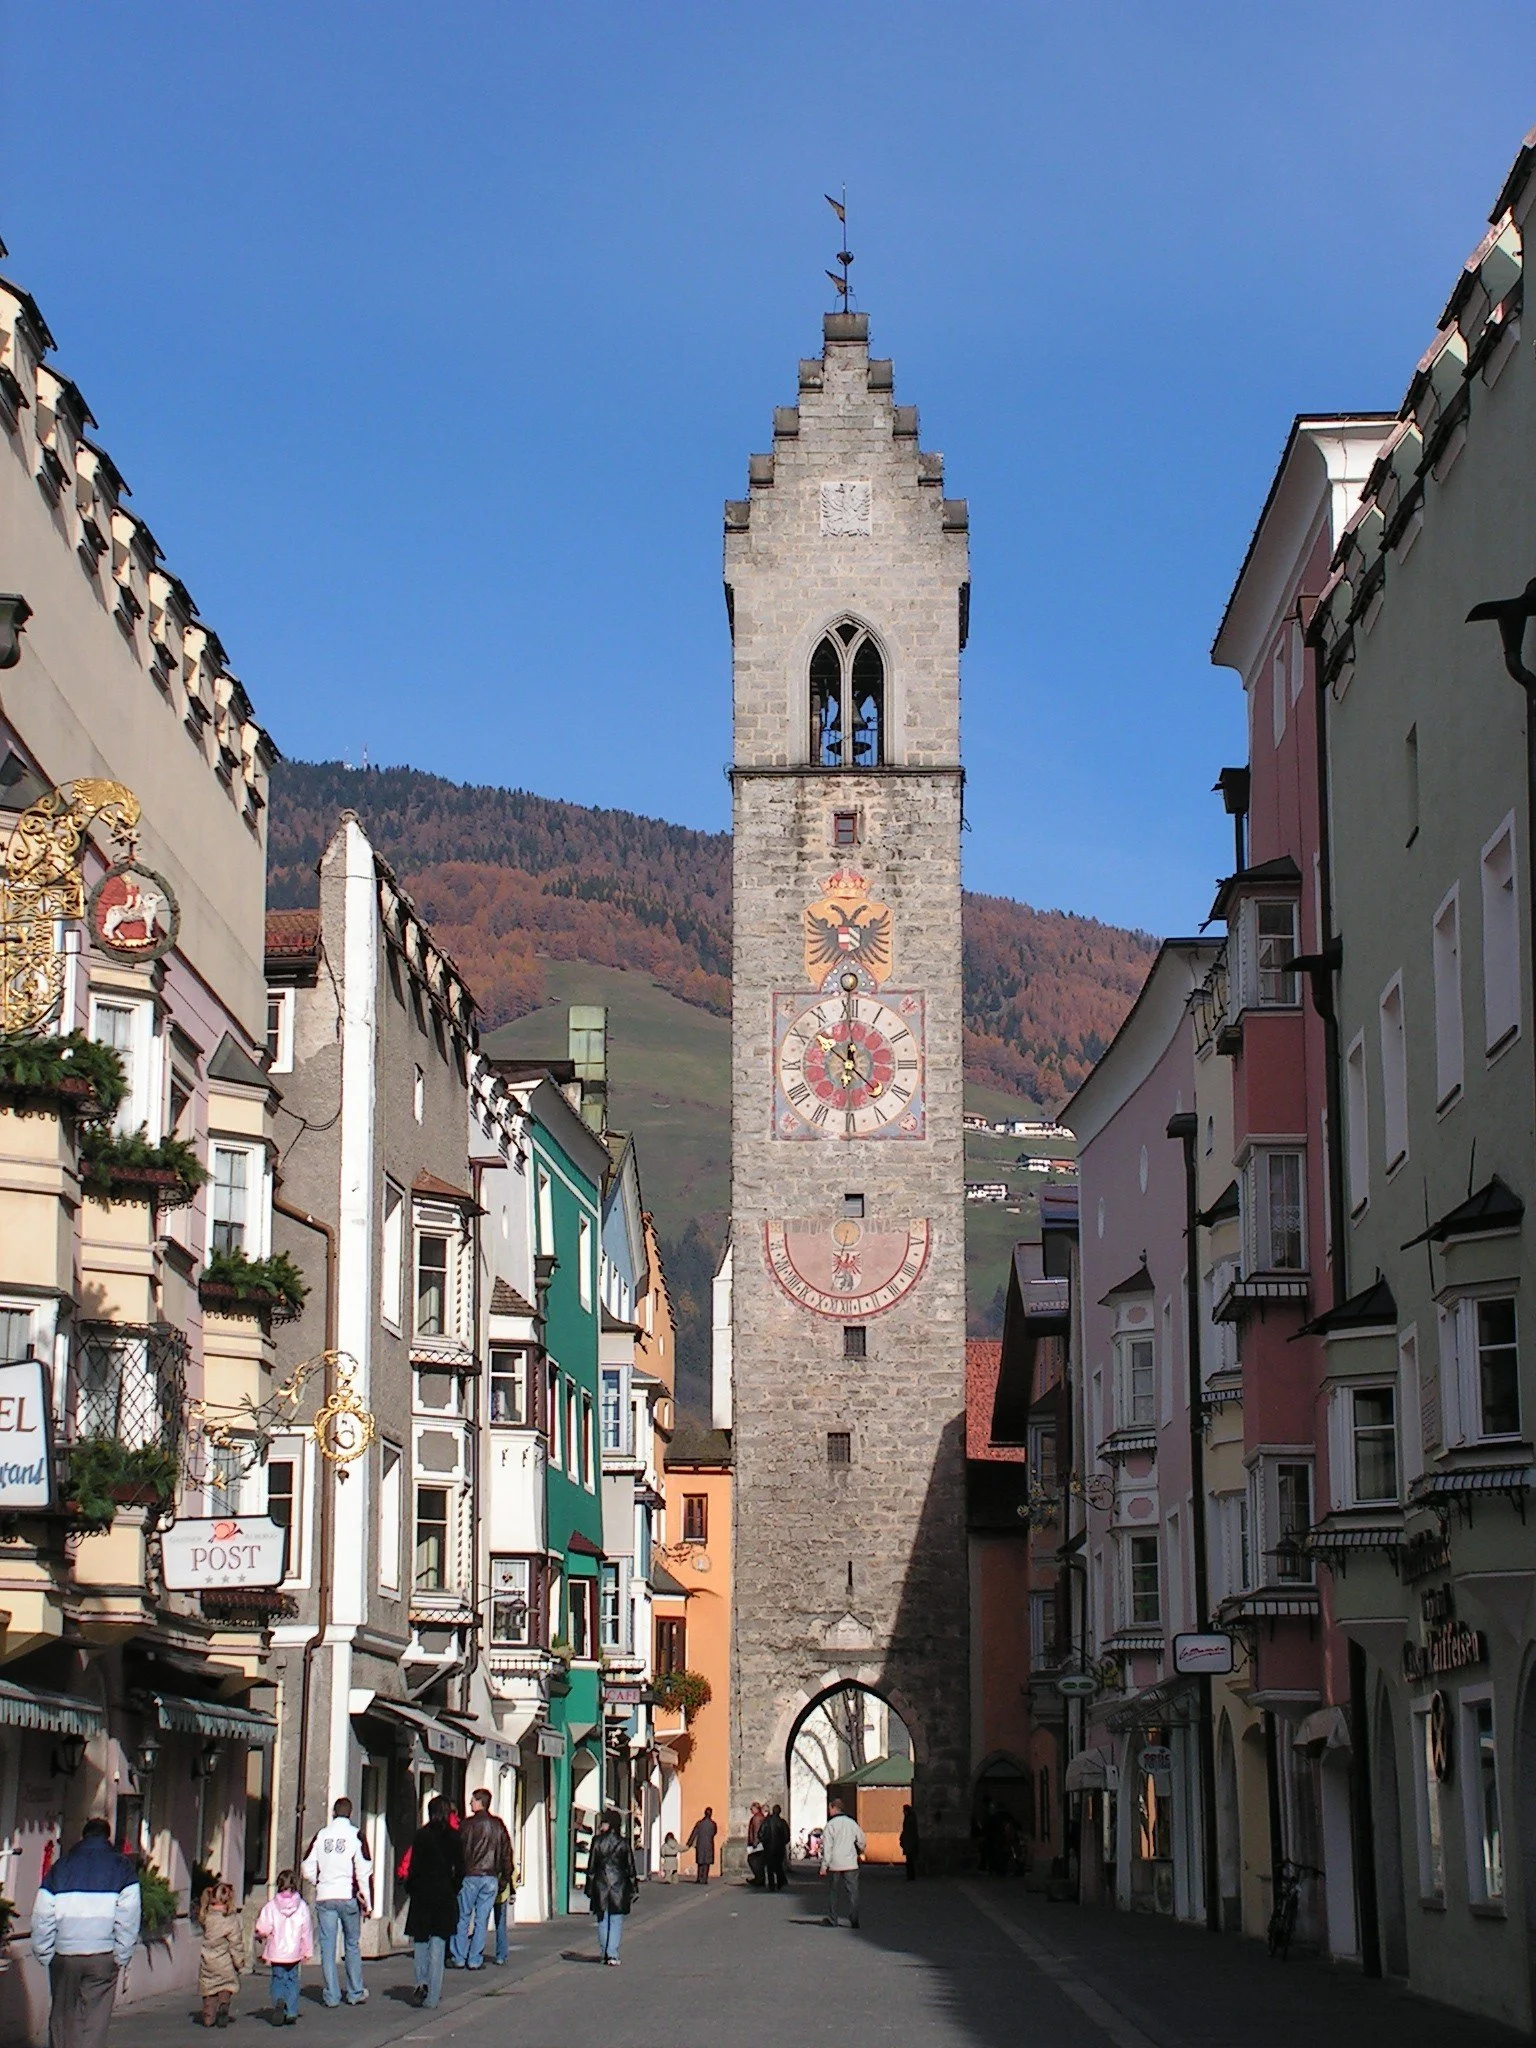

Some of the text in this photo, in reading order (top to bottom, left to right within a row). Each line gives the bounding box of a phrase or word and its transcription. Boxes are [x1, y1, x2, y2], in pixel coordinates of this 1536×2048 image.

[872, 1006, 884, 1025] I
[789, 1027, 810, 1045] X
[889, 1028, 910, 1044] II
[782, 1058, 801, 1071] IX
[897, 1059, 918, 1070] III
[873, 1105, 888, 1124] V
[190, 1545, 261, 1571] POST
